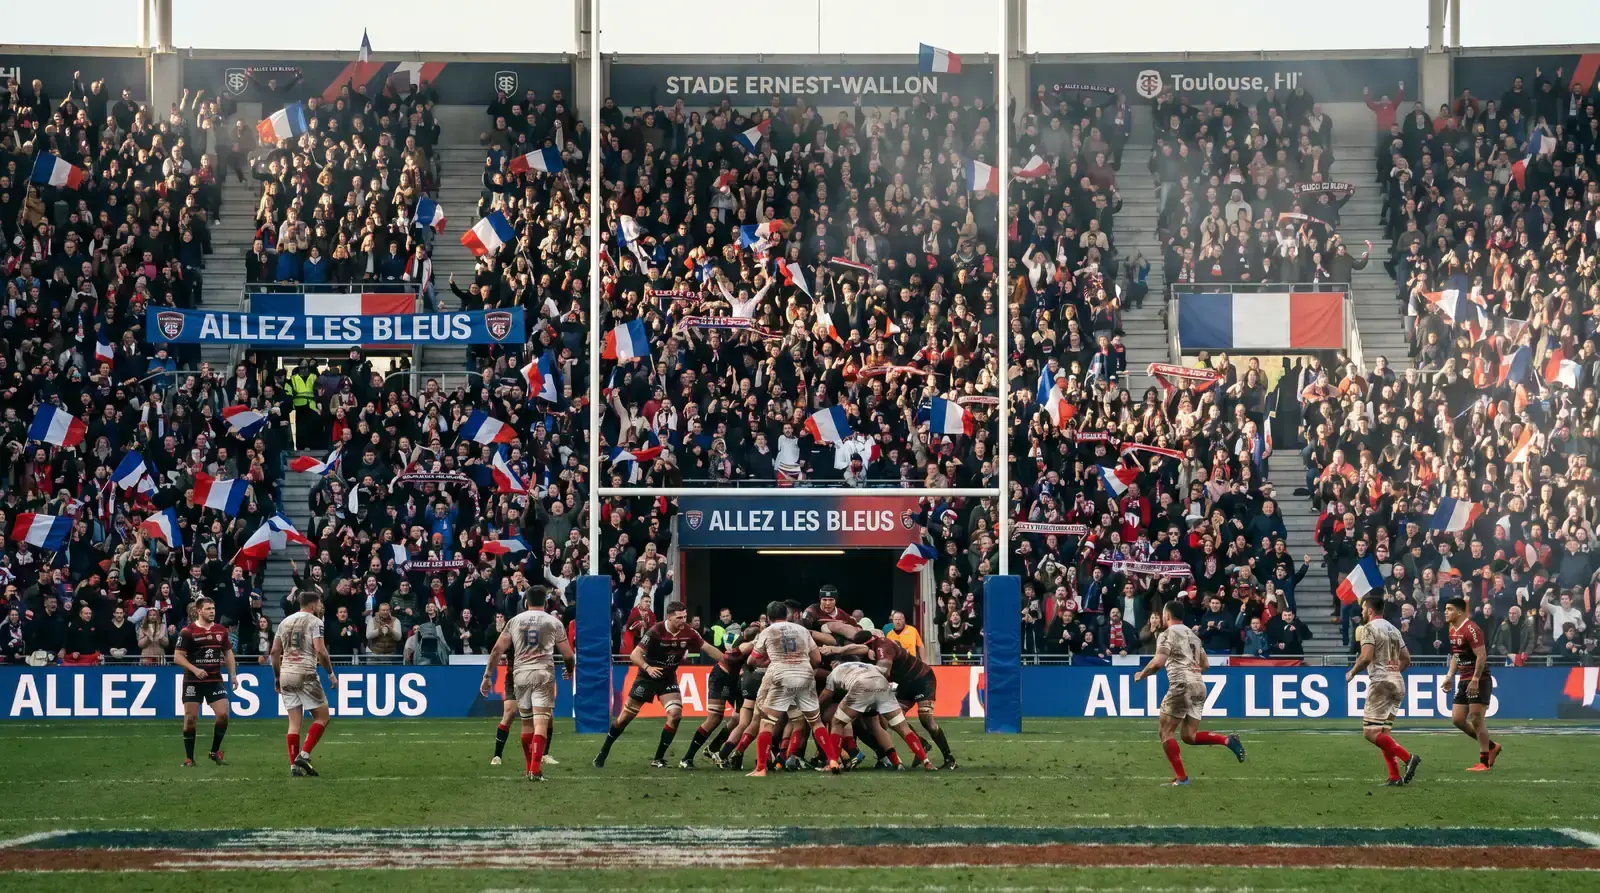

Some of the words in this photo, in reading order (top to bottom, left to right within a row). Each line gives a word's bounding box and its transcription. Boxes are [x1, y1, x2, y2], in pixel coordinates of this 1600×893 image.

[666, 76, 739, 94] STADE
[745, 76, 938, 94] ERNEST-WALLON
[1171, 72, 1269, 92] Toulouse,
[199, 313, 296, 341] ALLEZ
[305, 316, 362, 341] LES
[372, 314, 472, 341] BLEUS
[708, 510, 775, 531] ALLEZ
[781, 510, 820, 531] LES
[826, 510, 895, 531] BLEUS
[10, 674, 157, 717] ALLEZ
[278, 673, 428, 717] EUS
[1084, 674, 1228, 717] ALLZ
[1245, 674, 1330, 717] LES
